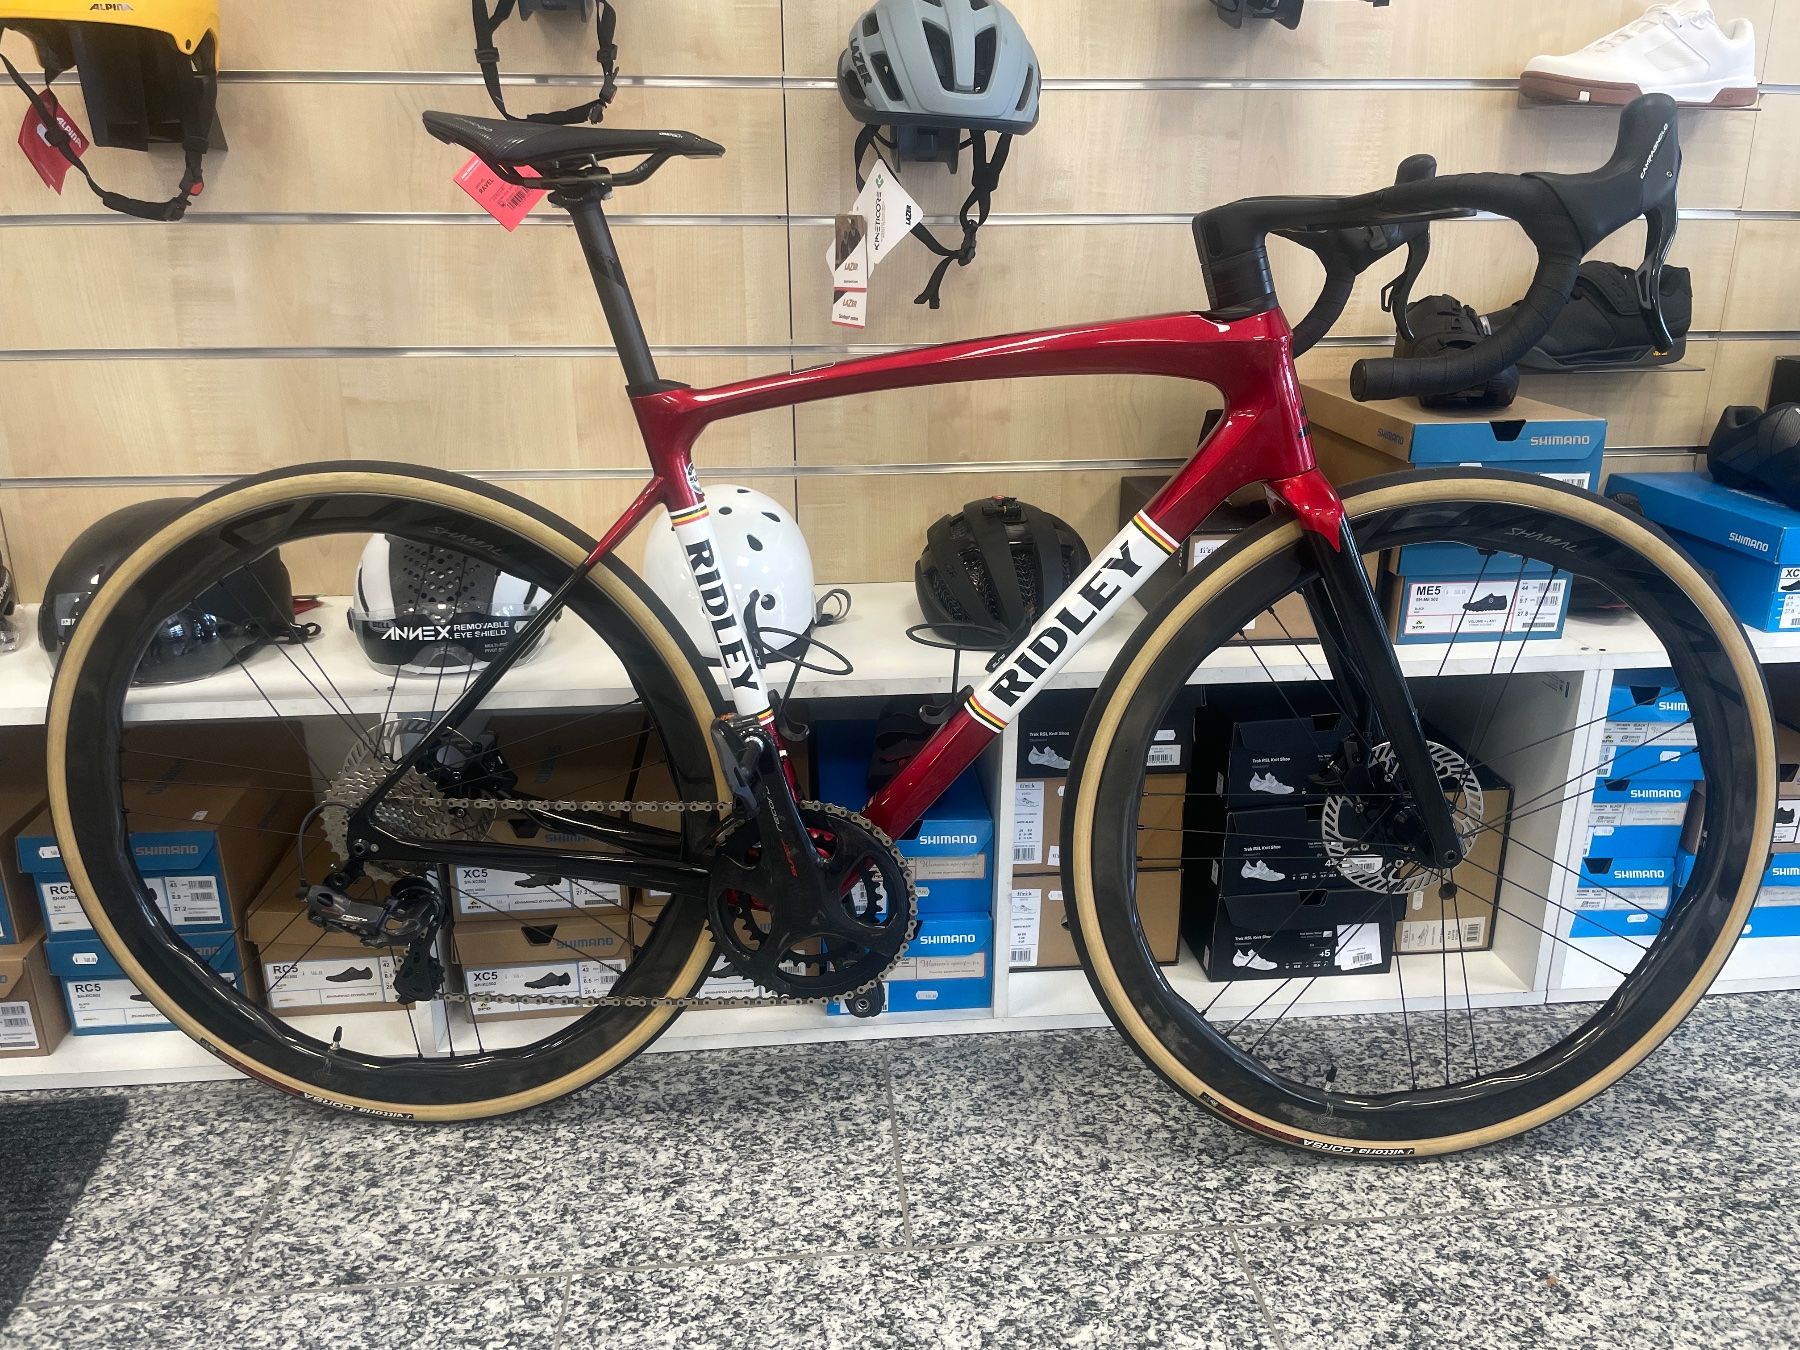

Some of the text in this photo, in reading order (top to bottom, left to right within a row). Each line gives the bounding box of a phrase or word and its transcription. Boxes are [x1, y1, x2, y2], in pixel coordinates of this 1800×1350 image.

[90, 3, 133, 11] ALPINA
[850, 38, 873, 88] LAZER
[56, 117, 83, 148] ALPINA
[1640, 123, 1669, 180] CAMPAGNOLO
[874, 192, 884, 251] KINETICORE
[1377, 427, 1405, 446] SHIMANO
[1530, 434, 1590, 447] SHIMANO
[1504, 527, 1580, 554] SHAMAL
[1728, 532, 1769, 553] SHIMANO
[1785, 567, 1800, 578] XC
[1416, 585, 1442, 596] ME5
[685, 538, 760, 691] RIDLEY
[453, 621, 510, 632] REMOVABLE
[988, 540, 1143, 708] RIDLEY
[474, 629, 507, 638] SHIELD
[1658, 701, 1690, 711] SHIM
[1630, 789, 1682, 799] SHIMANO
[919, 834, 977, 845] SHIMANO
[135, 844, 199, 856] SHIMANO
[463, 868, 488, 879] XC5
[1614, 868, 1665, 879] SHIMANO
[1772, 867, 1800, 876] SHIM
[555, 937, 614, 950] SHIMANO
[919, 934, 976, 945] SHIMANO
[273, 964, 299, 975] RC5
[473, 971, 498, 982] XC5
[75, 983, 102, 993] RC5
[303, 1092, 404, 1118] vittoria CORSA
[1303, 1139, 1405, 1156] vittoria CORSA
